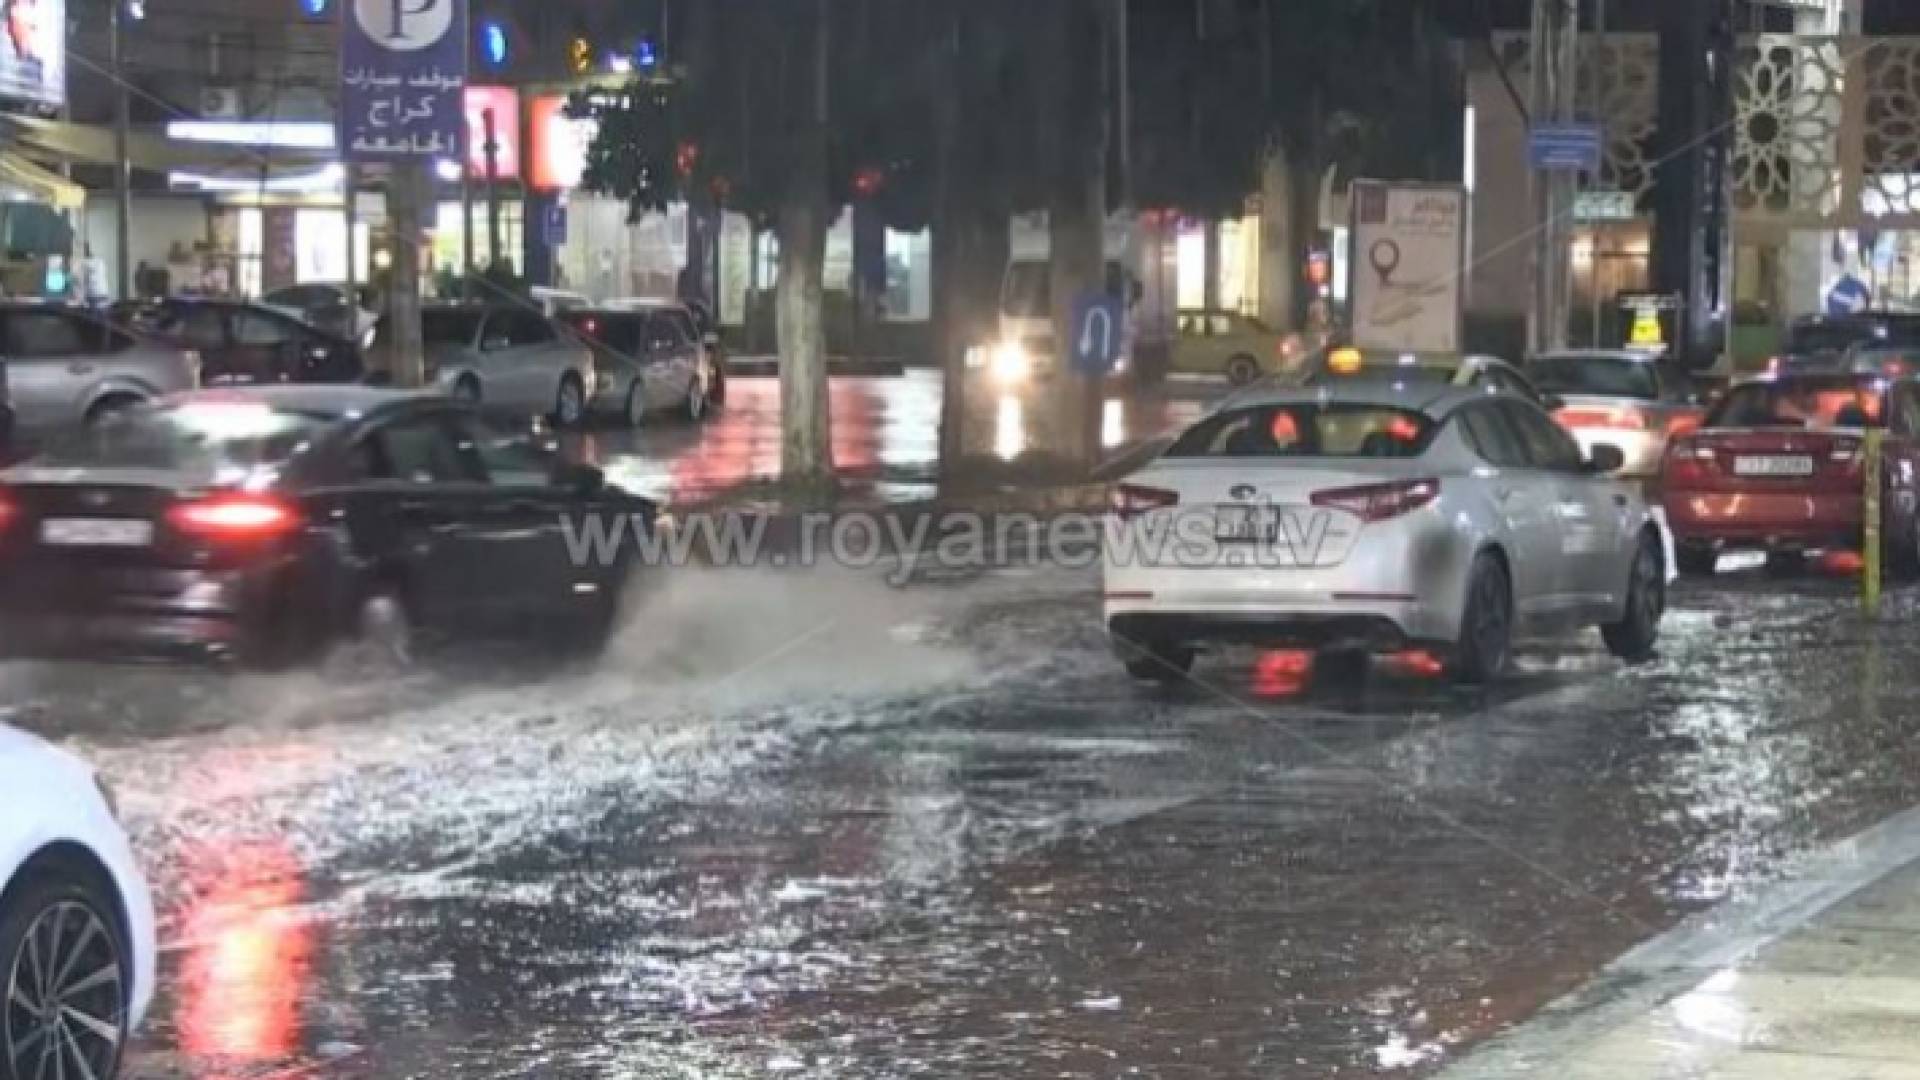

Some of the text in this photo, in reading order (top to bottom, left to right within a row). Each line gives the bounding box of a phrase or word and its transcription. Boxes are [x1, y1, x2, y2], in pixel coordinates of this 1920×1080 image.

[344, 64, 462, 93] موقف سيارات
[369, 95, 436, 127] كراج
